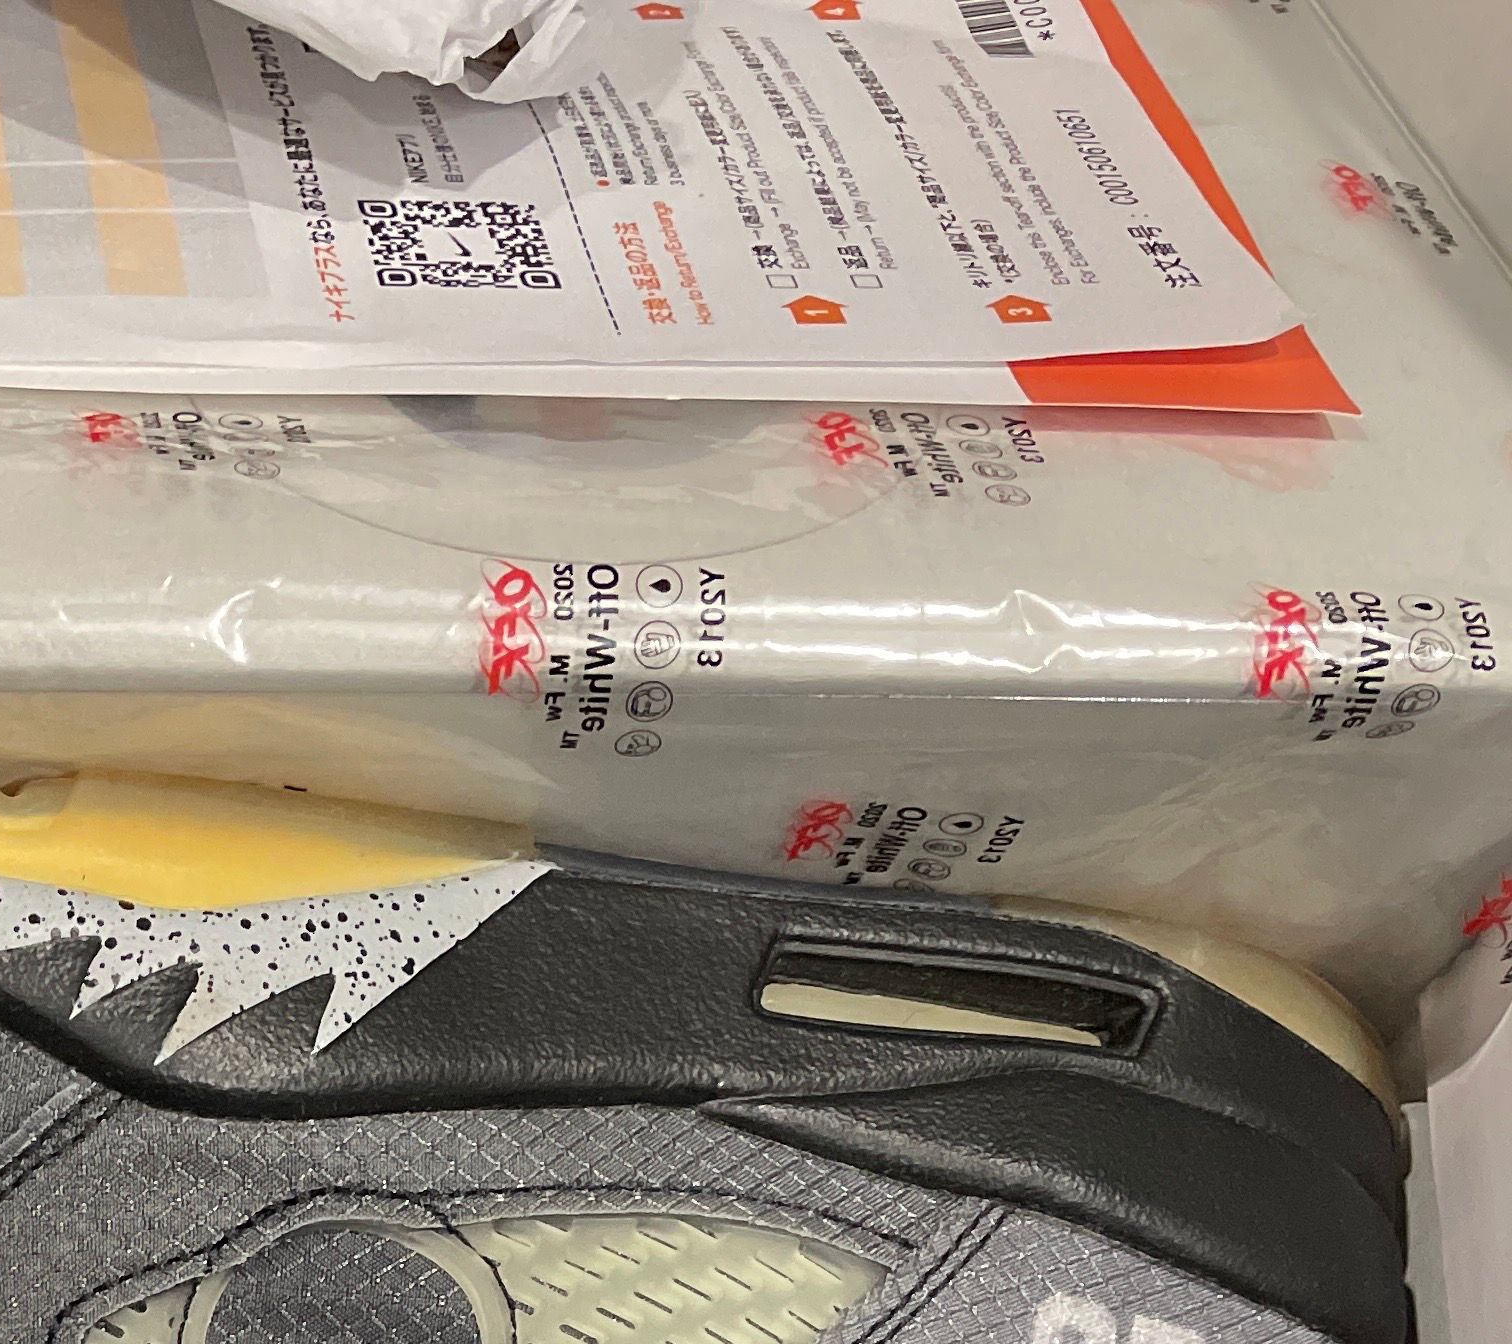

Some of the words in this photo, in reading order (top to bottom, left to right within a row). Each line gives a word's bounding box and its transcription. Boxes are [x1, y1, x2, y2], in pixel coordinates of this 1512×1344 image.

[1051, 109, 1140, 207] C00150610651
[653, 200, 694, 290] Return/Exchange
[751, 244, 783, 270] 交換
[777, 223, 811, 271] Exchange
[837, 244, 870, 270] 返品
[871, 236, 898, 271] Return
[612, 222, 678, 326] 交換・返品の方法
[1037, 251, 1071, 286] Enclose
[695, 303, 716, 326] How
[802, 306, 830, 318] 1
[1006, 305, 1035, 318] 3
